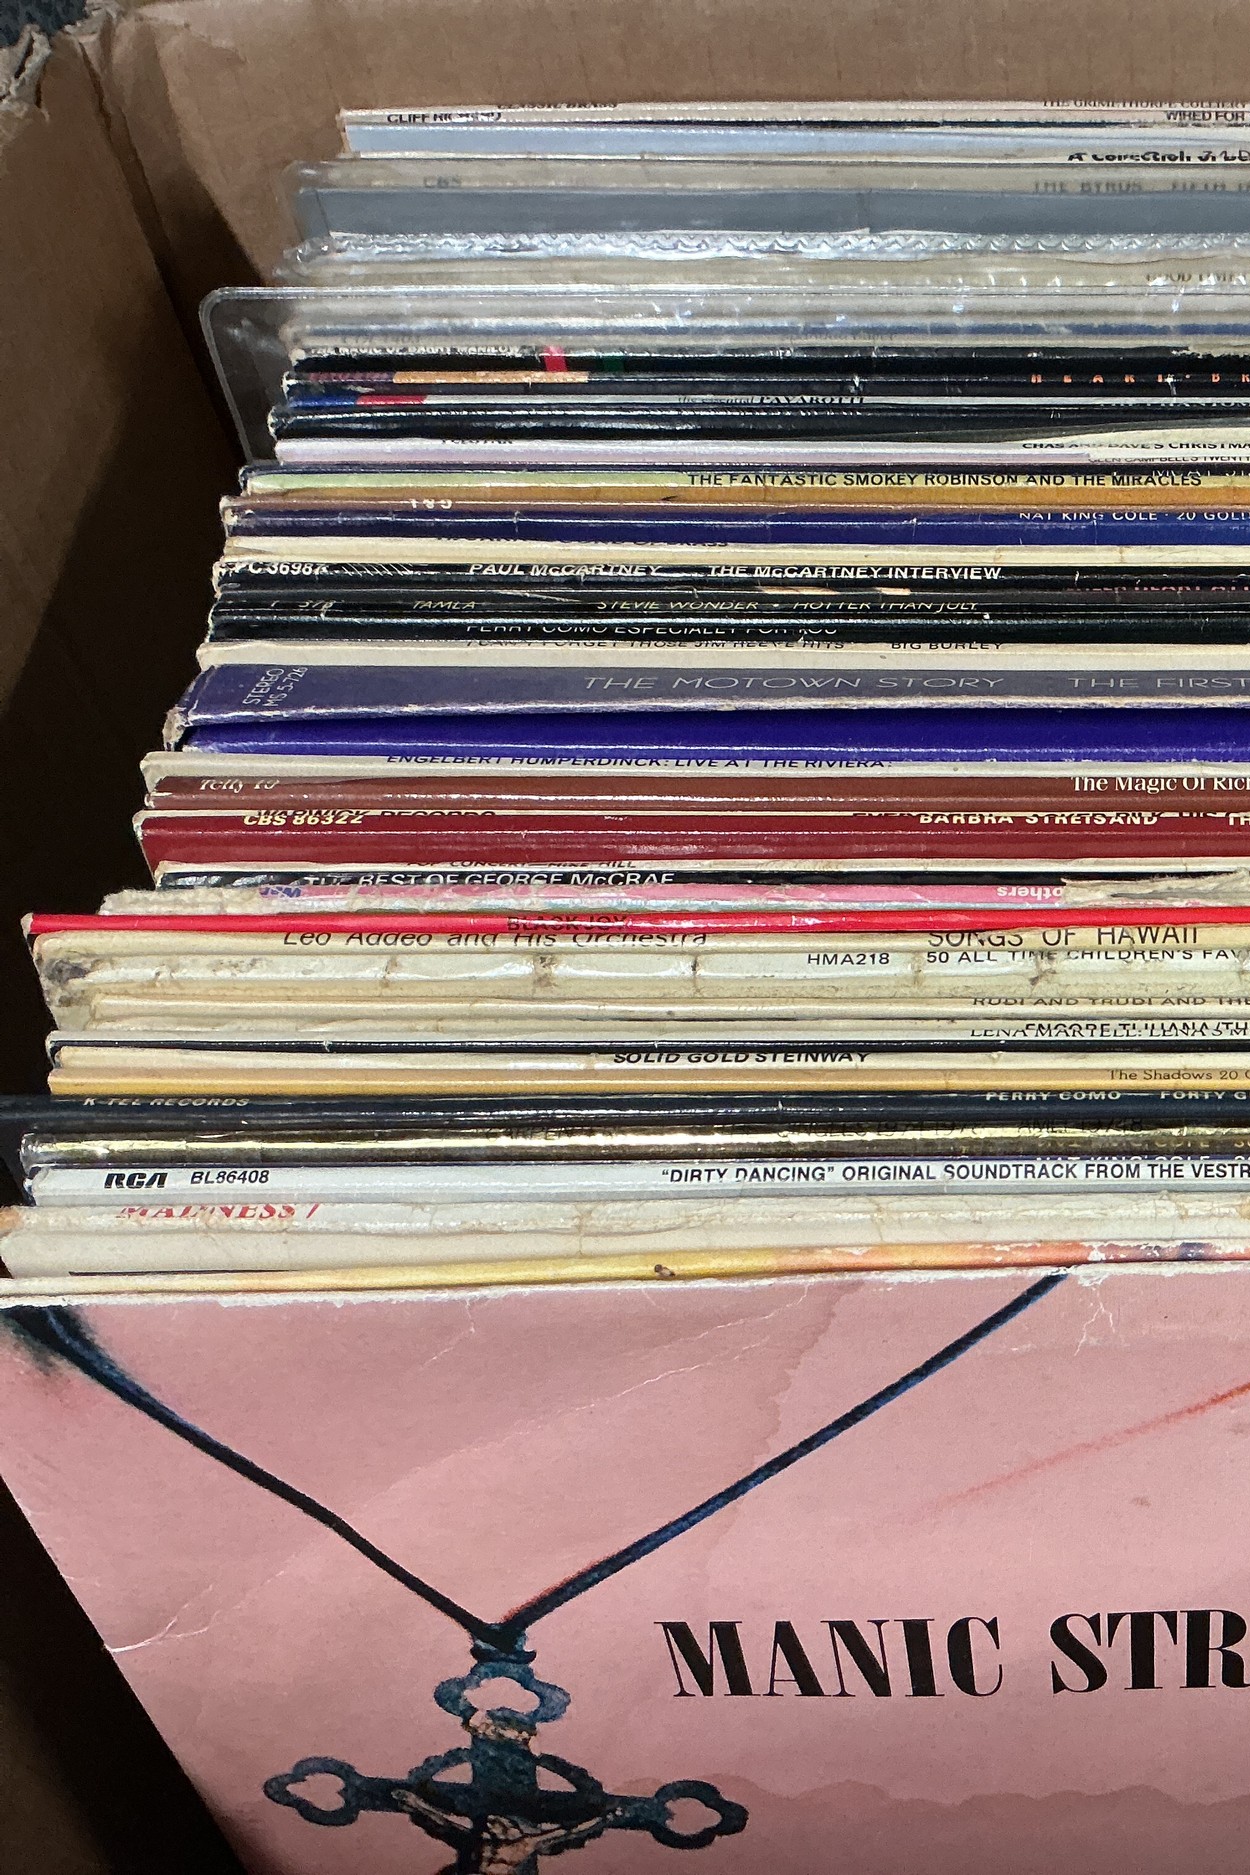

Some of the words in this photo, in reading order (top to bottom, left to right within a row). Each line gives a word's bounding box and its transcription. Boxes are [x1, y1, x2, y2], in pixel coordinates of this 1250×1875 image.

[1166, 110, 1212, 122] WIRED
[1215, 110, 1246, 122] FOR
[688, 474, 725, 486] THE
[730, 474, 837, 486] FANTASTIC
[843, 474, 919, 486] SMOKEY
[924, 474, 1018, 486] ROBINSON
[1026, 474, 1065, 487] AND
[1071, 474, 1106, 487] THE
[1111, 474, 1202, 487] MIRACLES
[1061, 512, 1104, 521] KING
[1112, 512, 1158, 521] COLE
[1175, 512, 1196, 521] 20
[469, 562, 525, 577] PAUL
[530, 564, 662, 577] McCARTNEY
[709, 565, 750, 578] THE
[754, 566, 883, 579] McCARTNEY
[887, 567, 1002, 580] INTERVIEW
[413, 600, 477, 610] TAMLA
[669, 601, 760, 610] WONDER
[242, 667, 285, 706] STEREO
[584, 676, 659, 689] THE
[673, 676, 861, 690] MOTOWN
[878, 677, 1005, 690] STORY
[1067, 677, 1140, 689] THE
[675, 759, 718, 768] LIVE
[1070, 776, 1110, 792] The
[1114, 776, 1179, 795] Magic
[243, 815, 287, 826] CBS
[292, 814, 365, 826] 86322
[358, 874, 422, 886] BEST
[283, 932, 332, 946] Leo
[927, 929, 1024, 947] SONGS
[1042, 928, 1076, 946] OF
[1097, 925, 1198, 944] HAWAII
[807, 952, 891, 967] HMA218
[926, 951, 949, 964] 50
[958, 950, 998, 964] ALL
[613, 1052, 681, 1063] SOLID
[686, 1053, 748, 1063] GOLD
[755, 1053, 869, 1063] STEINWAY
[1108, 1069, 1138, 1081] The
[1142, 1068, 1214, 1081] Shadows
[1219, 1069, 1239, 1081] 20
[149, 1096, 250, 1107] RECORDS
[985, 1091, 1050, 1101] PERRY
[1059, 1091, 1122, 1101] COMO
[1160, 1090, 1225, 1100] FORTY
[103, 1172, 168, 1189] RCA
[190, 1169, 270, 1185] BL86408
[661, 1166, 728, 1184] “DIRTY
[736, 1165, 835, 1183] DANCING”
[842, 1164, 937, 1182] ORIGINAL
[943, 1163, 1078, 1180] SOUNDTRACK
[1084, 1163, 1141, 1180] FROM
[1149, 1163, 1186, 1180] THE
[655, 1616, 1005, 1699] MANIC
